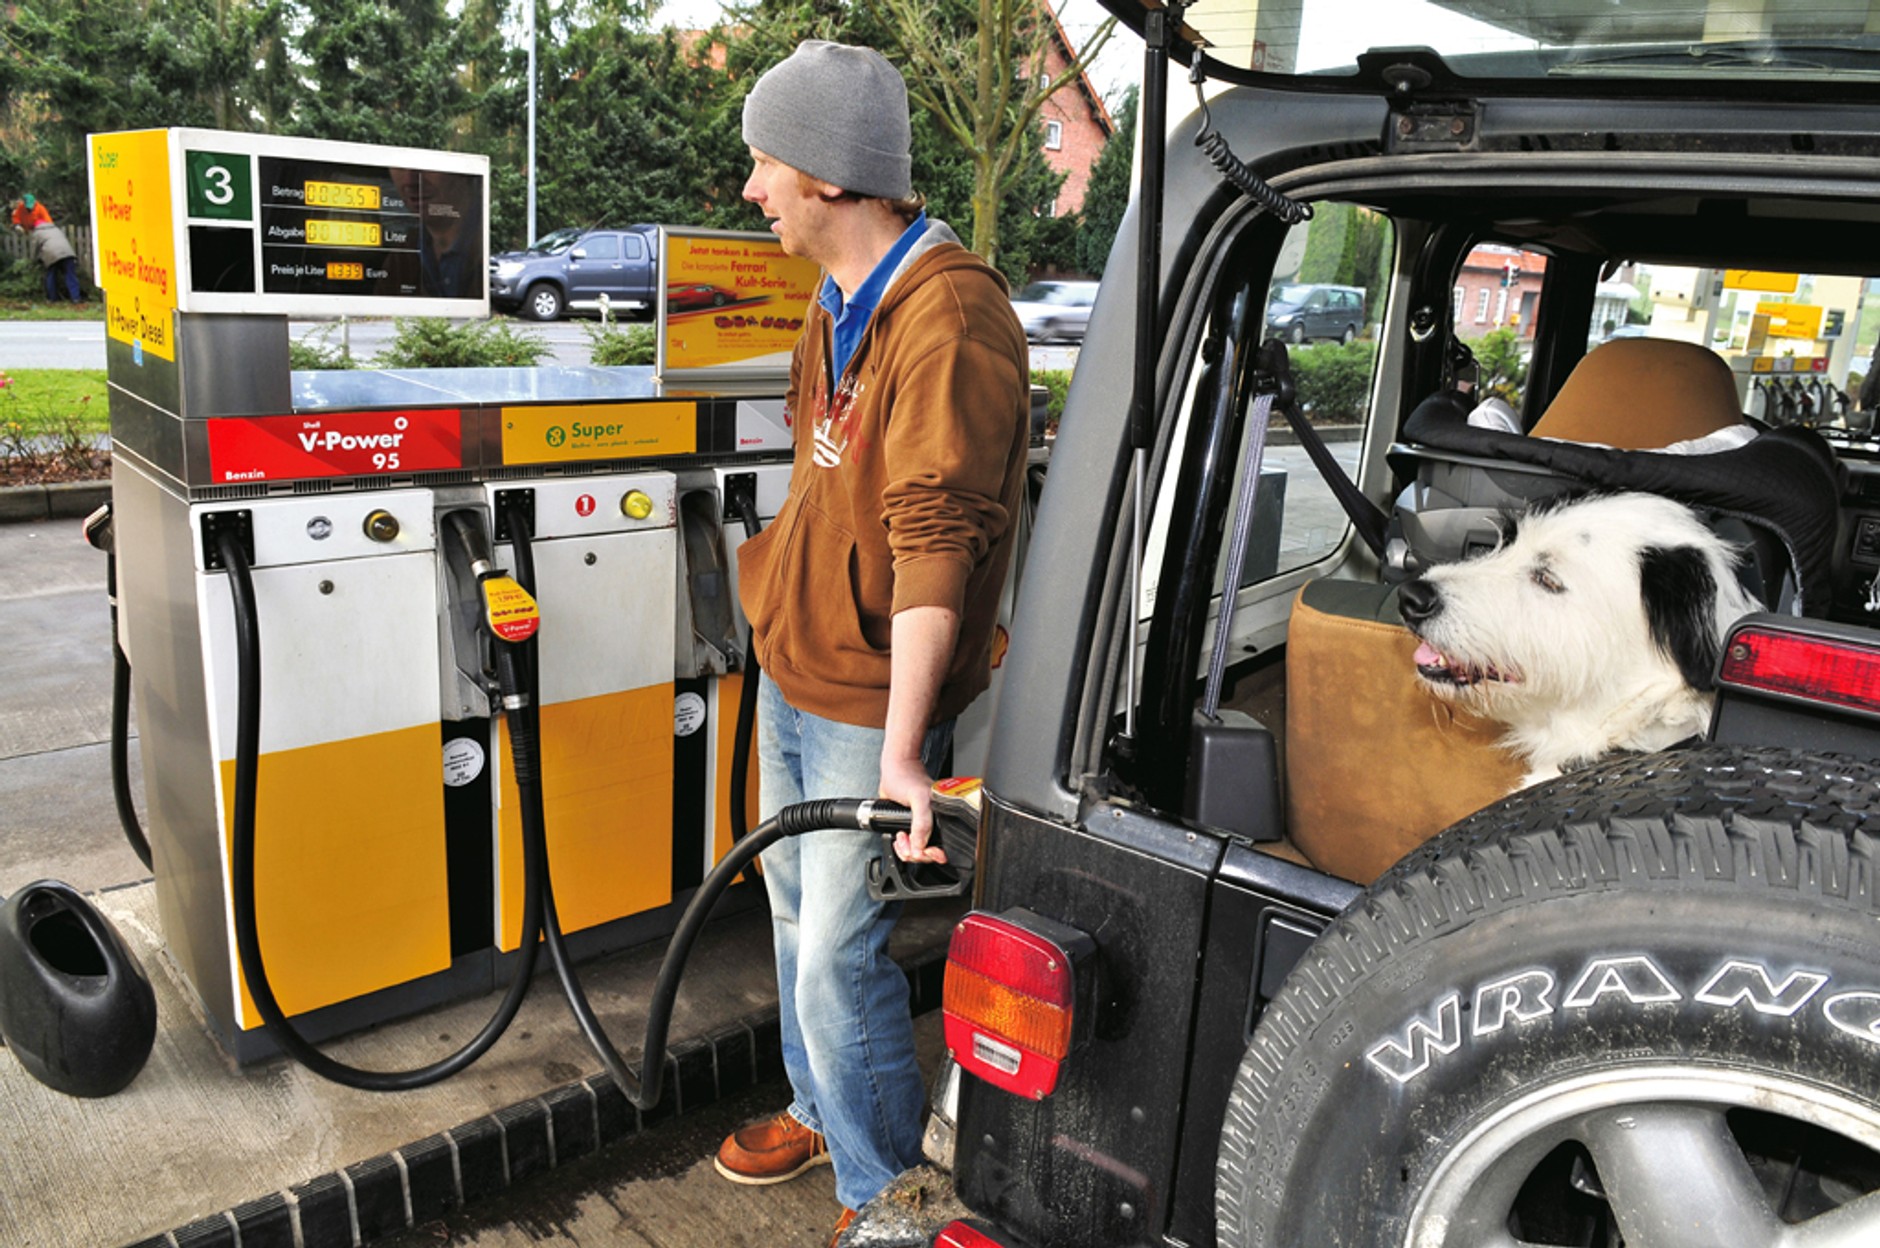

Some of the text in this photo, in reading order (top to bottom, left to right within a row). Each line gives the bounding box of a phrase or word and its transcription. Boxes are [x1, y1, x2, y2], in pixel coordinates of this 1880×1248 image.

[204, 165, 235, 205] 3
[272, 185, 304, 200] Betrag
[382, 196, 404, 208] Euro
[101, 194, 132, 222] V-Power
[268, 225, 305, 240] Abgabe
[384, 231, 407, 243] Liter
[689, 245, 710, 256] Jetzt
[743, 247, 750, 257] &
[105, 249, 167, 295] V-Power Racing
[271, 264, 295, 275] Preis
[295, 265, 304, 277] je
[305, 264, 326, 276] Liter
[366, 268, 389, 279] Euro
[730, 260, 767, 273] Ferrari
[735, 275, 787, 289] Kult-Serie
[108, 304, 166, 346] V-Power Diesel
[303, 421, 321, 429] Shell
[571, 421, 624, 440] Super
[297, 431, 404, 453] V-Power
[739, 437, 764, 446] Benzin
[371, 453, 401, 470] 95
[225, 469, 266, 481] Benzin
[581, 496, 591, 512] 1
